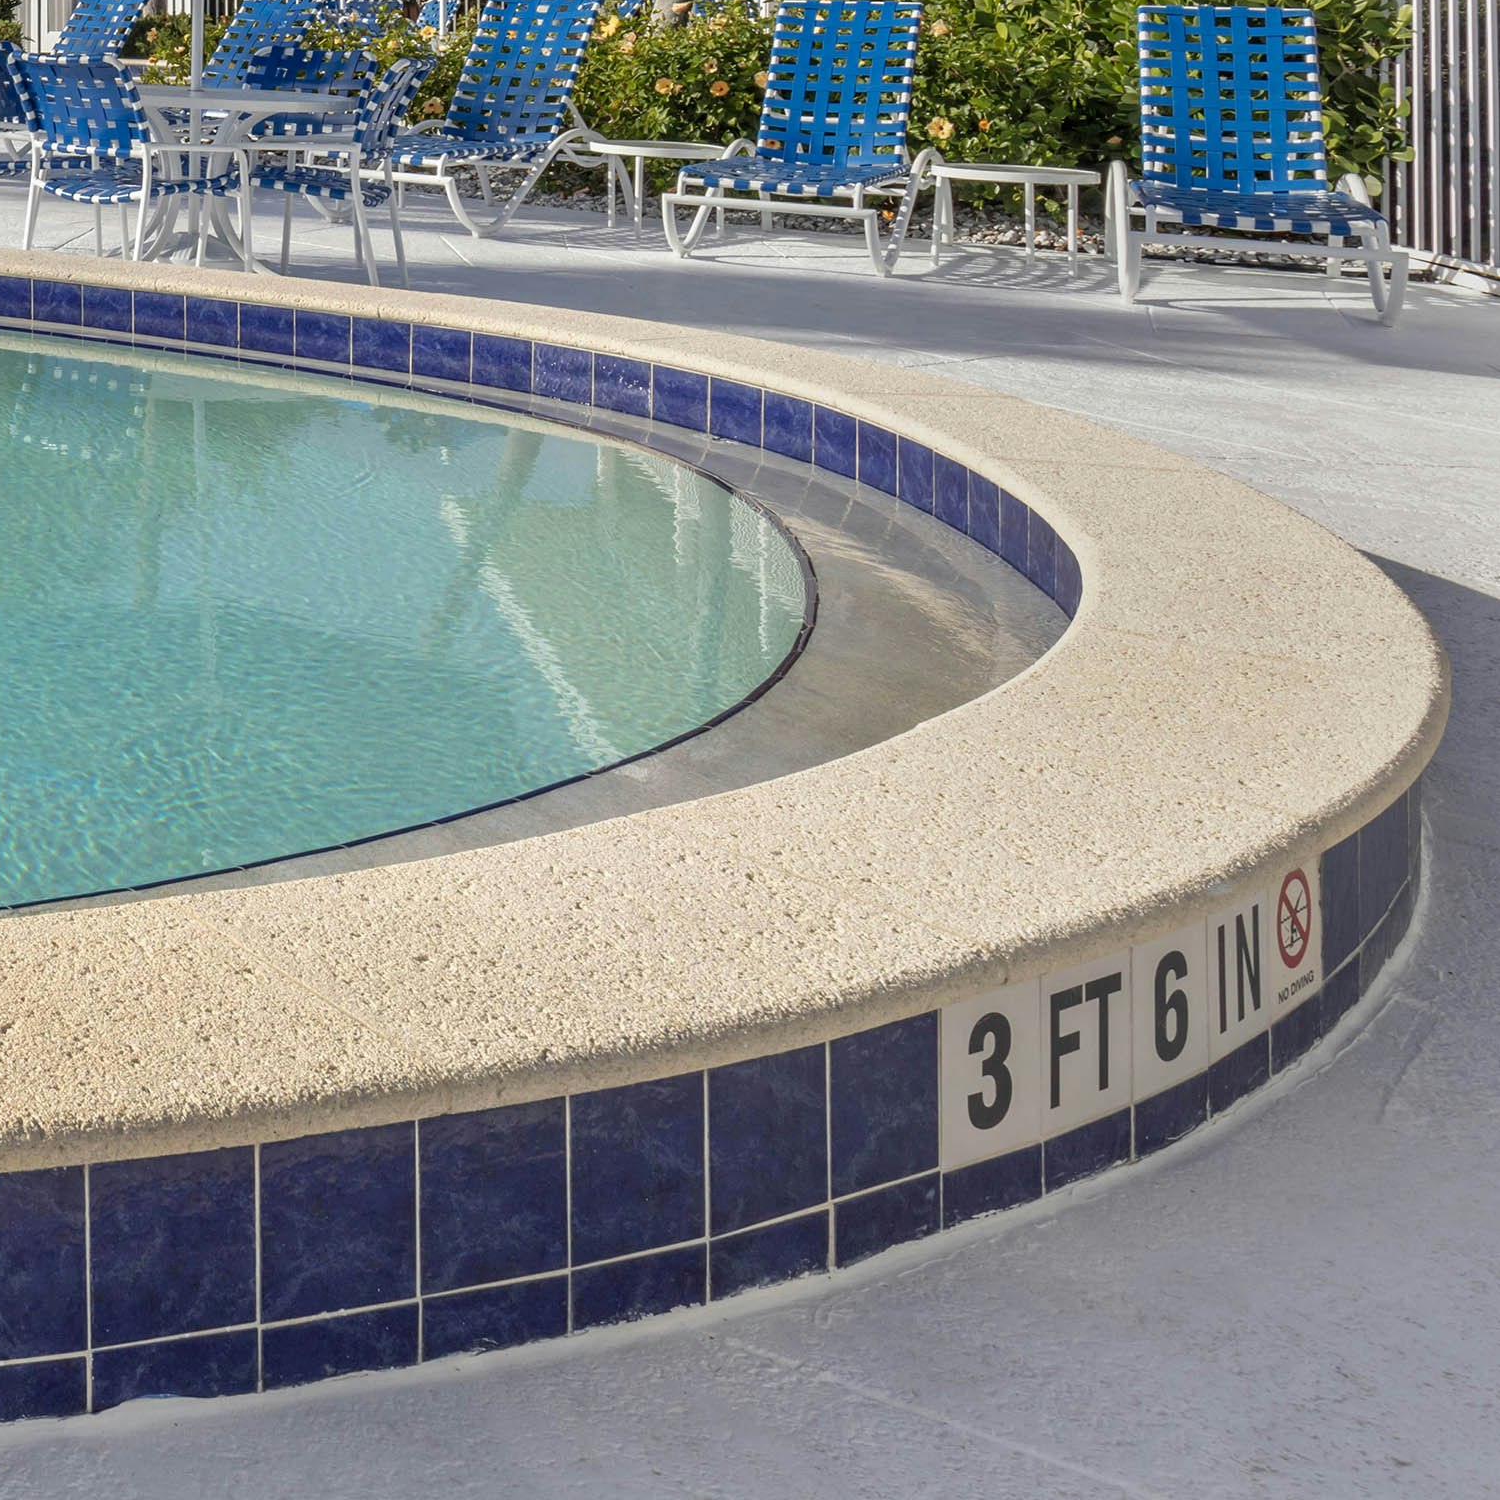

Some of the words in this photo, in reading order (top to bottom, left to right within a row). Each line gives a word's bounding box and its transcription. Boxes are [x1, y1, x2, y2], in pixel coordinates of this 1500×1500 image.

[967, 1011, 1013, 1130] 3
[1050, 971, 1122, 1109] FT
[1154, 950, 1189, 1062] 6
[1217, 903, 1262, 1035] IN
[1278, 987, 1289, 1005] NO
[1290, 970, 1315, 997] DIVING
